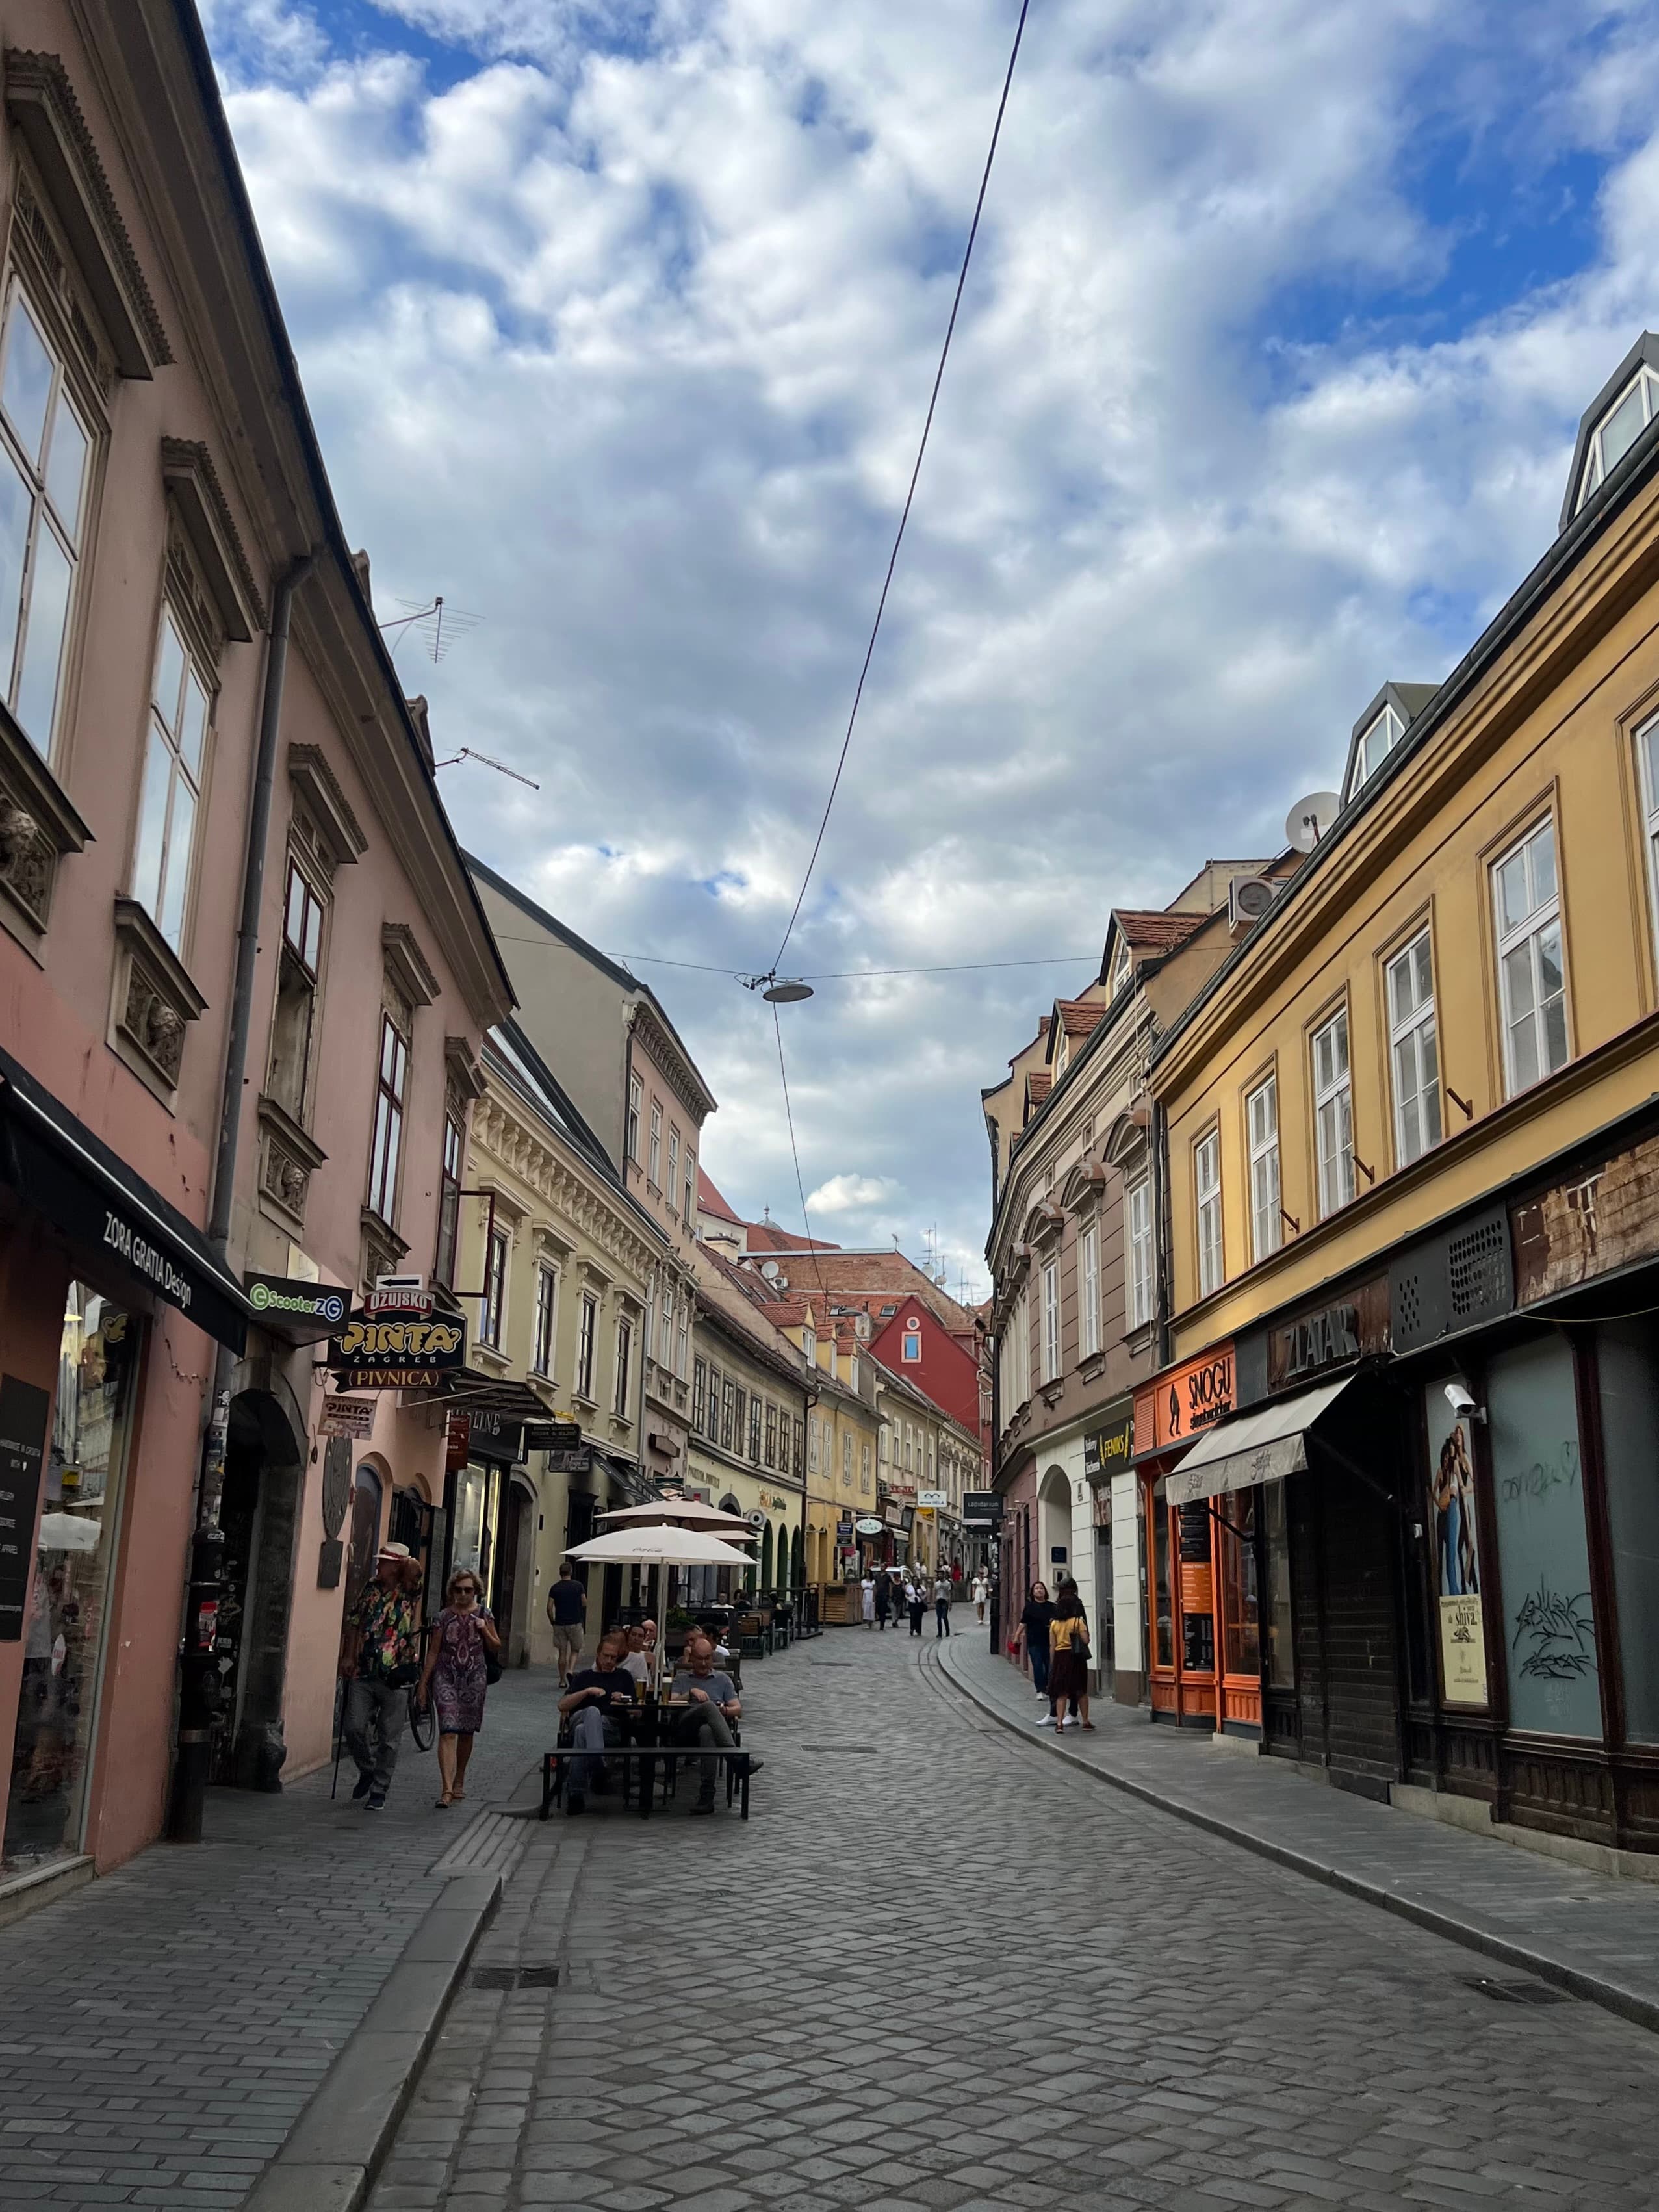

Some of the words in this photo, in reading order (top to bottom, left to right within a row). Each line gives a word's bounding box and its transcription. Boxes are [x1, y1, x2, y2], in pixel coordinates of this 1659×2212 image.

[103, 1211, 131, 1259] ZORA
[133, 1237, 164, 1285] GRATIA
[164, 1262, 192, 1309] Design
[333, 1322, 463, 1356] PINTA
[326, 1402, 373, 1415] PINTA
[1104, 1434, 1124, 1458] FENIKS
